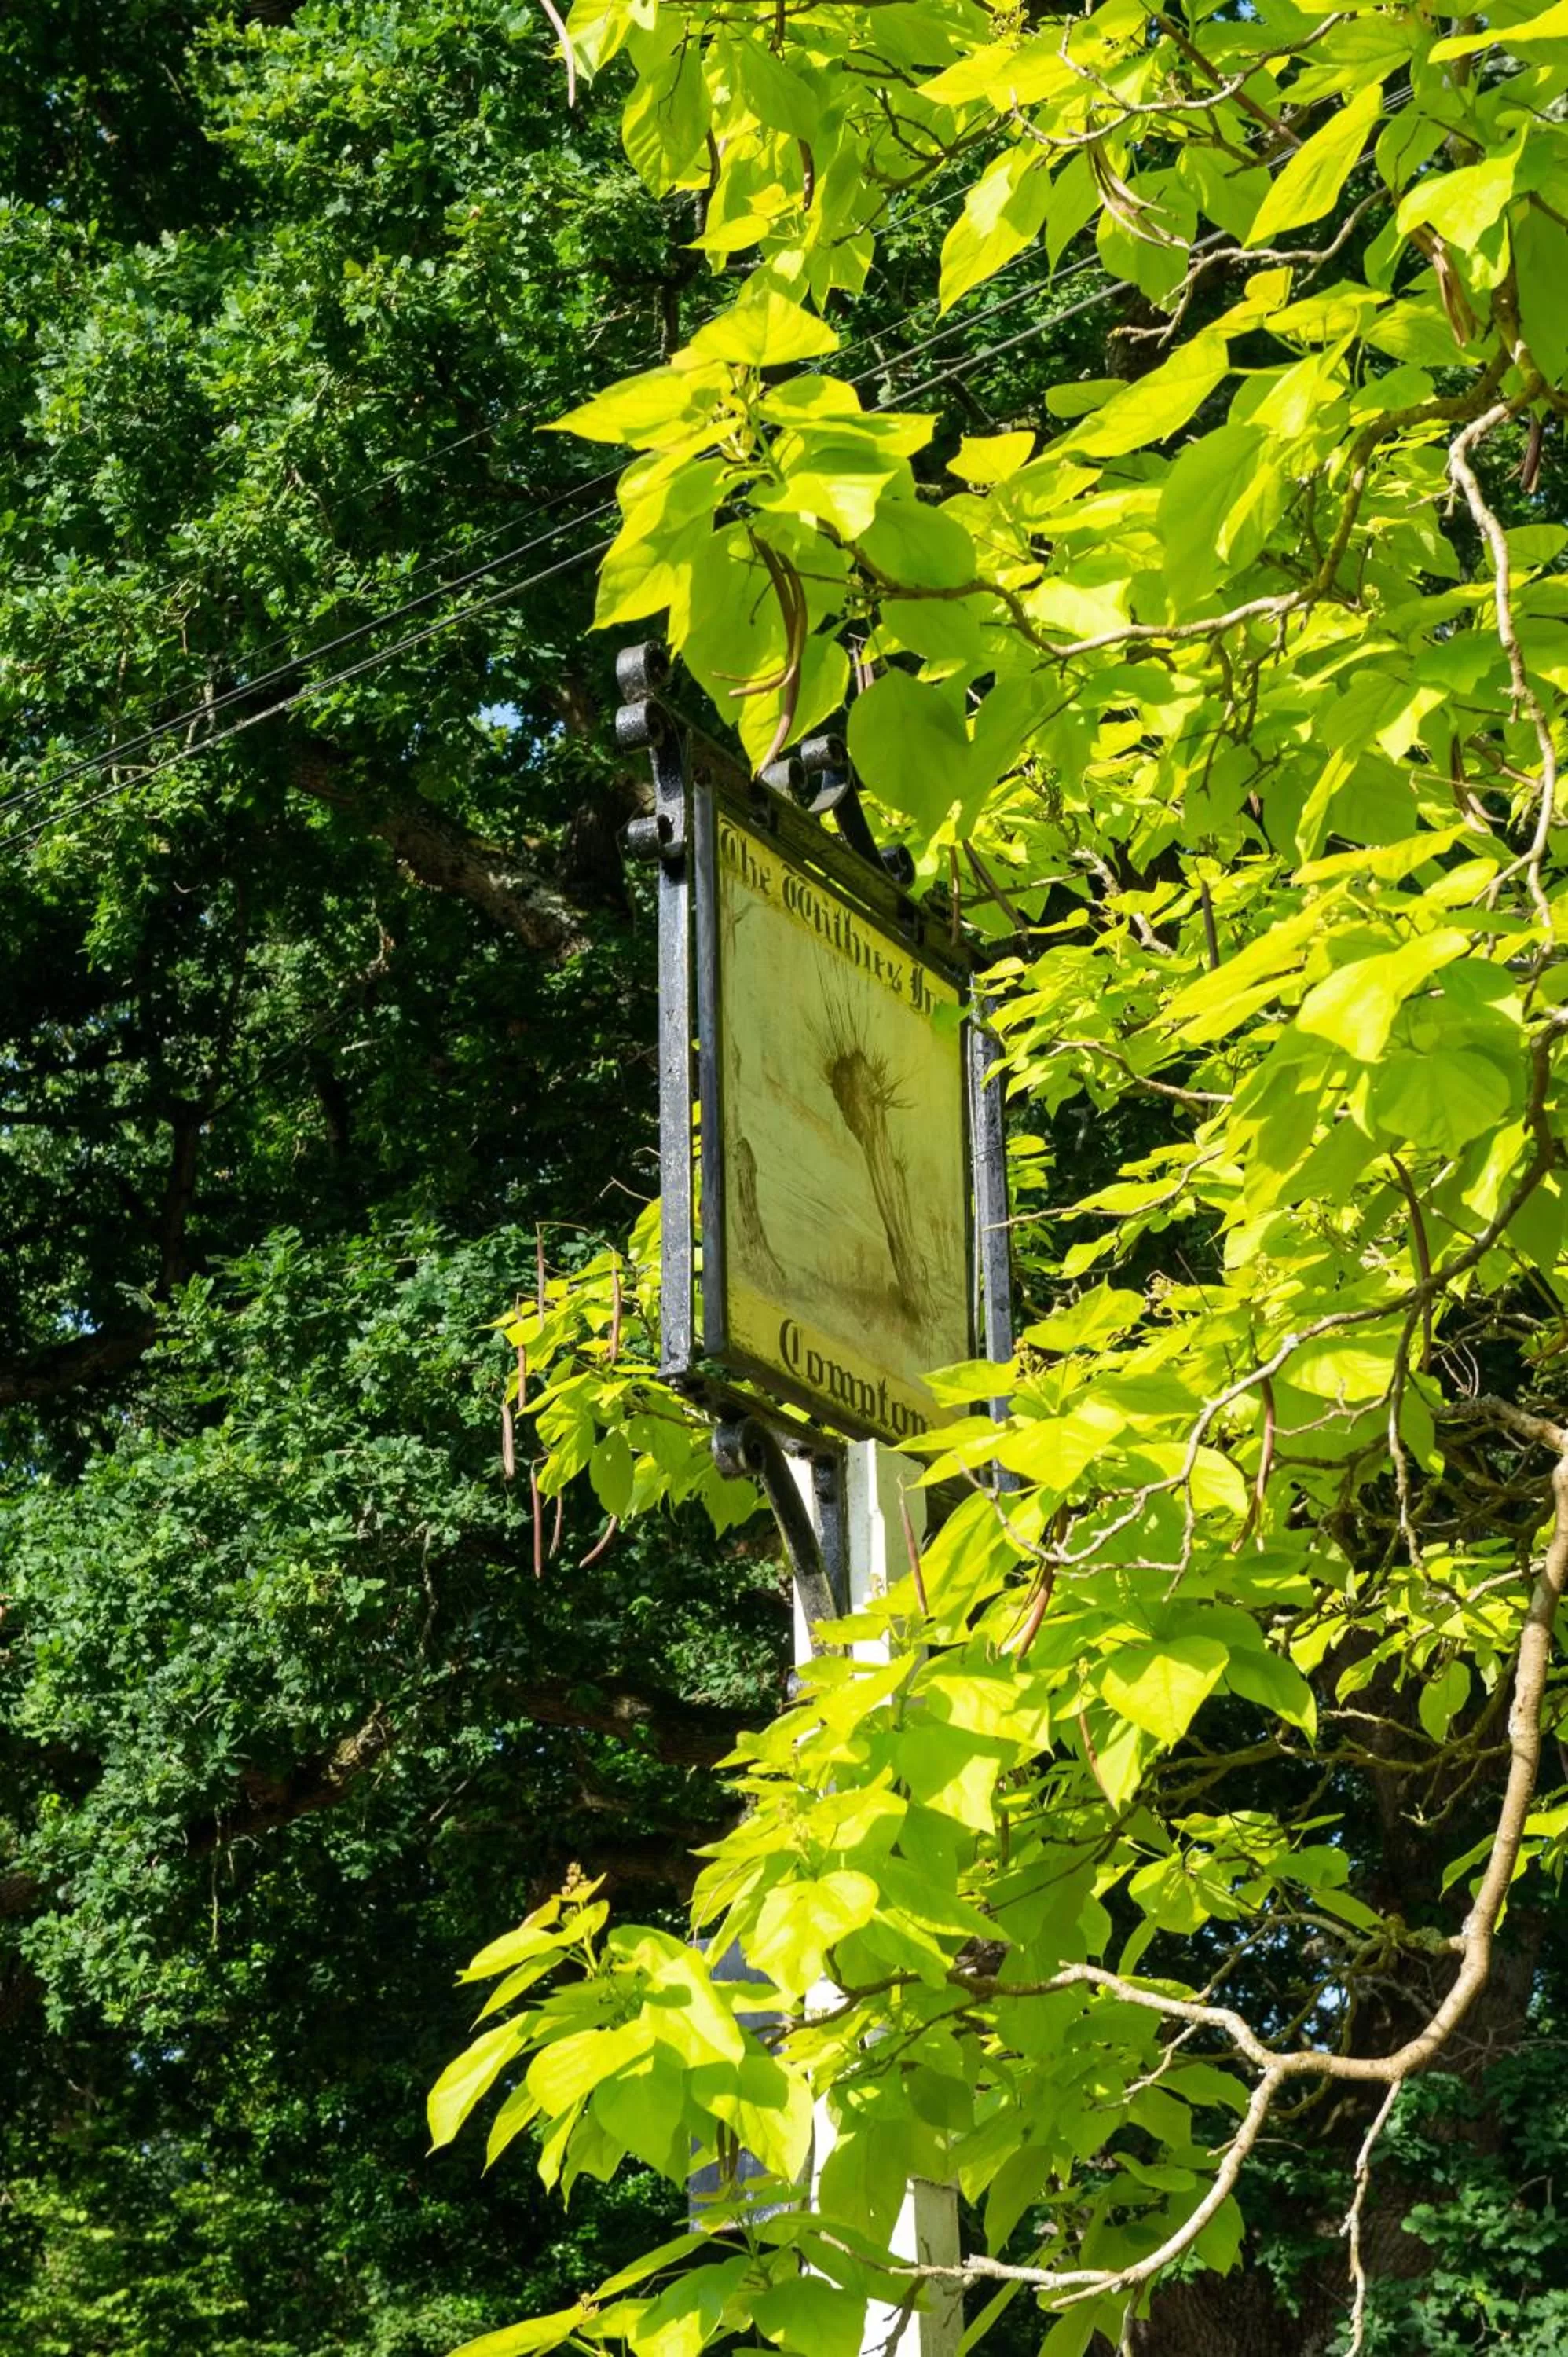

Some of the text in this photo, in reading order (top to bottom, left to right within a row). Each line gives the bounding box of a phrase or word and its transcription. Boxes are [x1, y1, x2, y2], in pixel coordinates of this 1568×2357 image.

[720, 819, 939, 1016] The Withies In
[779, 1319, 928, 1437] Compton
